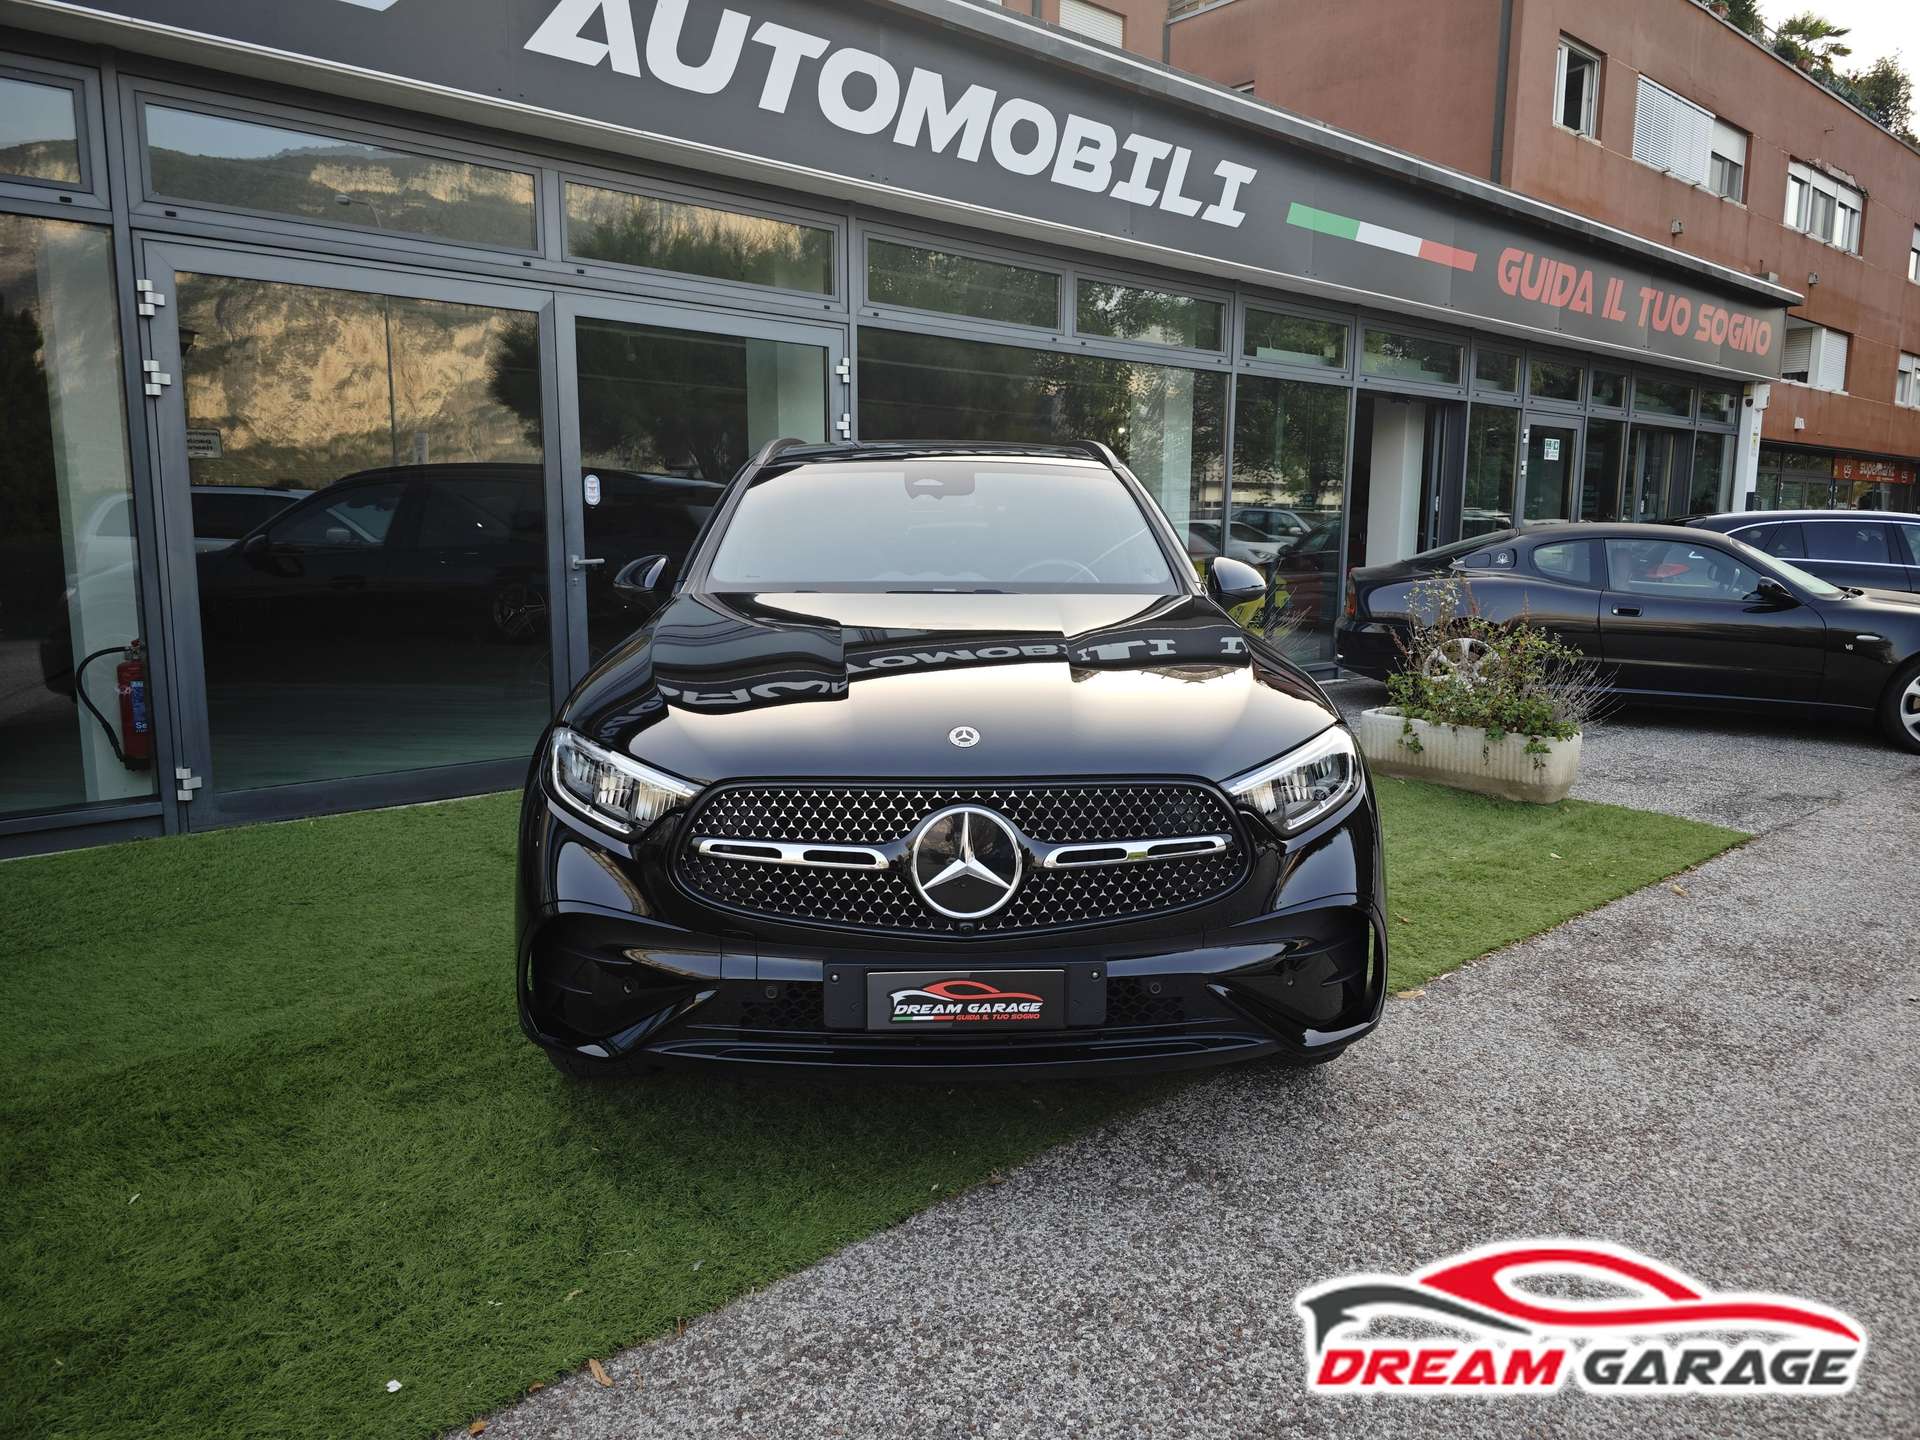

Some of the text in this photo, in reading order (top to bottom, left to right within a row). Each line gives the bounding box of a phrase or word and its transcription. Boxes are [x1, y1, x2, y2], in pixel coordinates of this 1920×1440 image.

[524, 0, 1257, 227] AUTOMOBILI
[1498, 248, 1772, 356] GUIDA IL TUO SOGNO
[894, 1002, 1043, 1015] DREAM GARAGE
